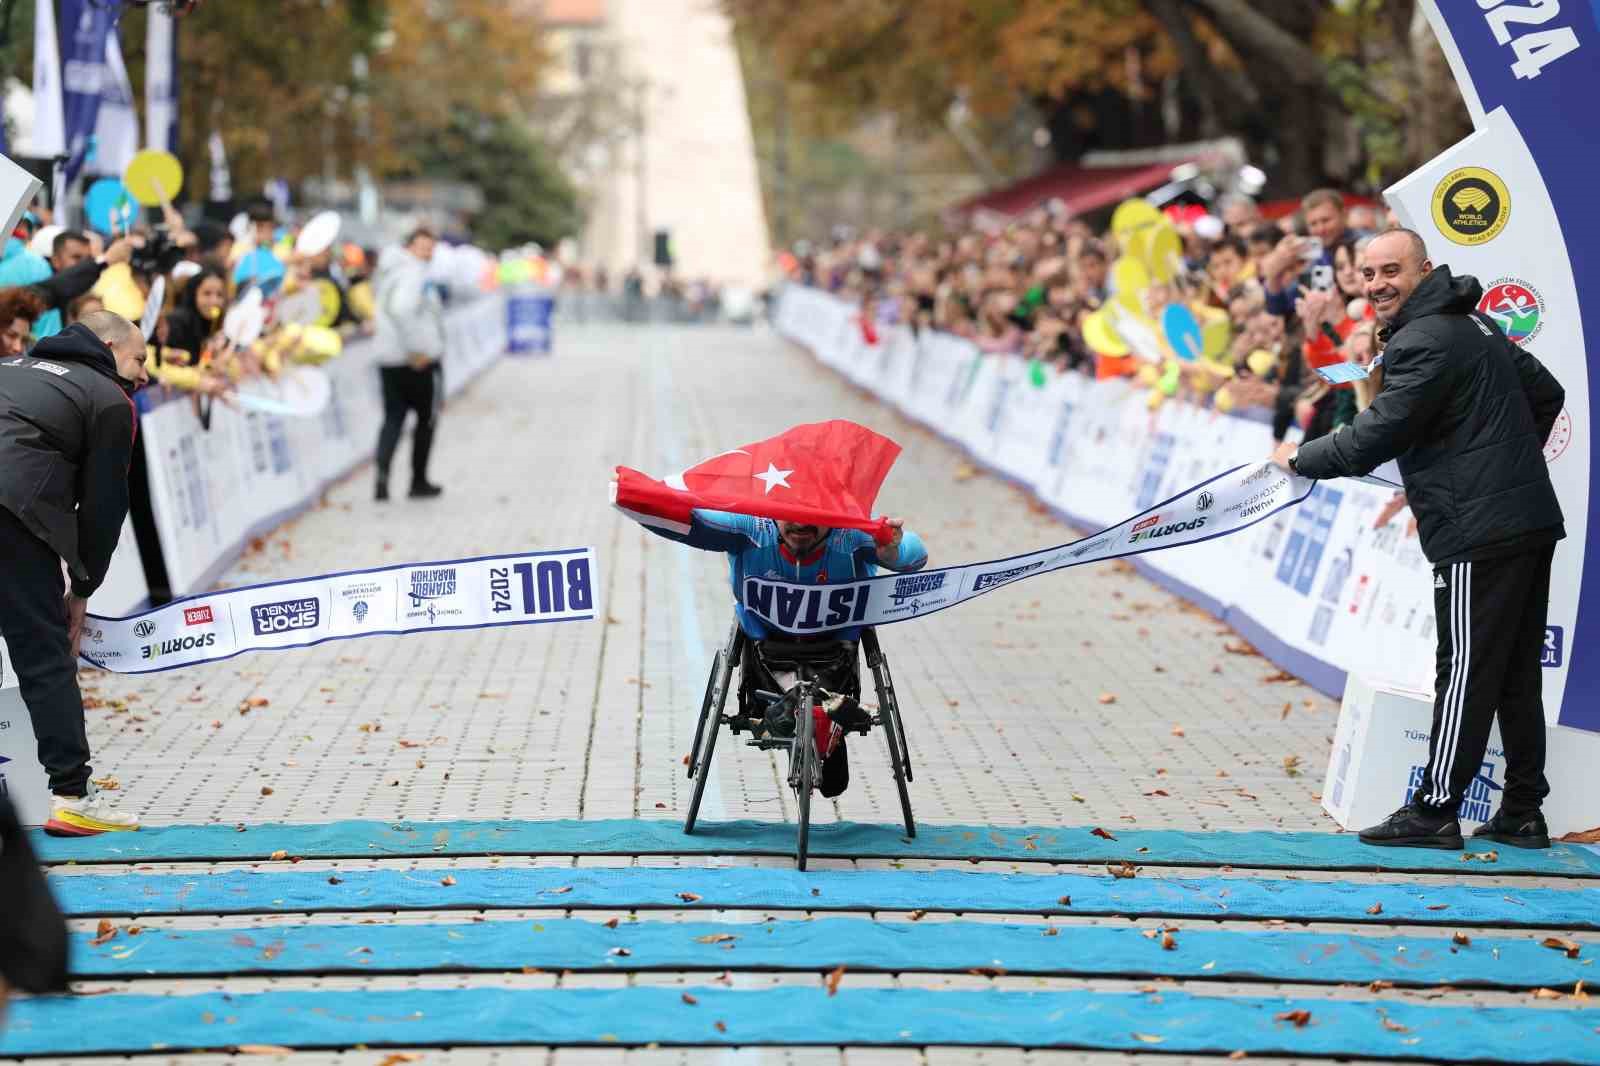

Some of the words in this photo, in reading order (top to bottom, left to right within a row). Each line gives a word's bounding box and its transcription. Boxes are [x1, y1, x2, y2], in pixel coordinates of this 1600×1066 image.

[1476, 0, 1580, 80] 24
[1128, 516, 1208, 544] SPORTIVE
[410, 568, 457, 583] MARATHON
[513, 557, 593, 614] BUL
[490, 567, 512, 614] 2024
[135, 621, 155, 637] MG
[257, 612, 317, 633] SPOR
[141, 632, 216, 661] SPORTIVE
[1404, 730, 1432, 743] TÜRK
